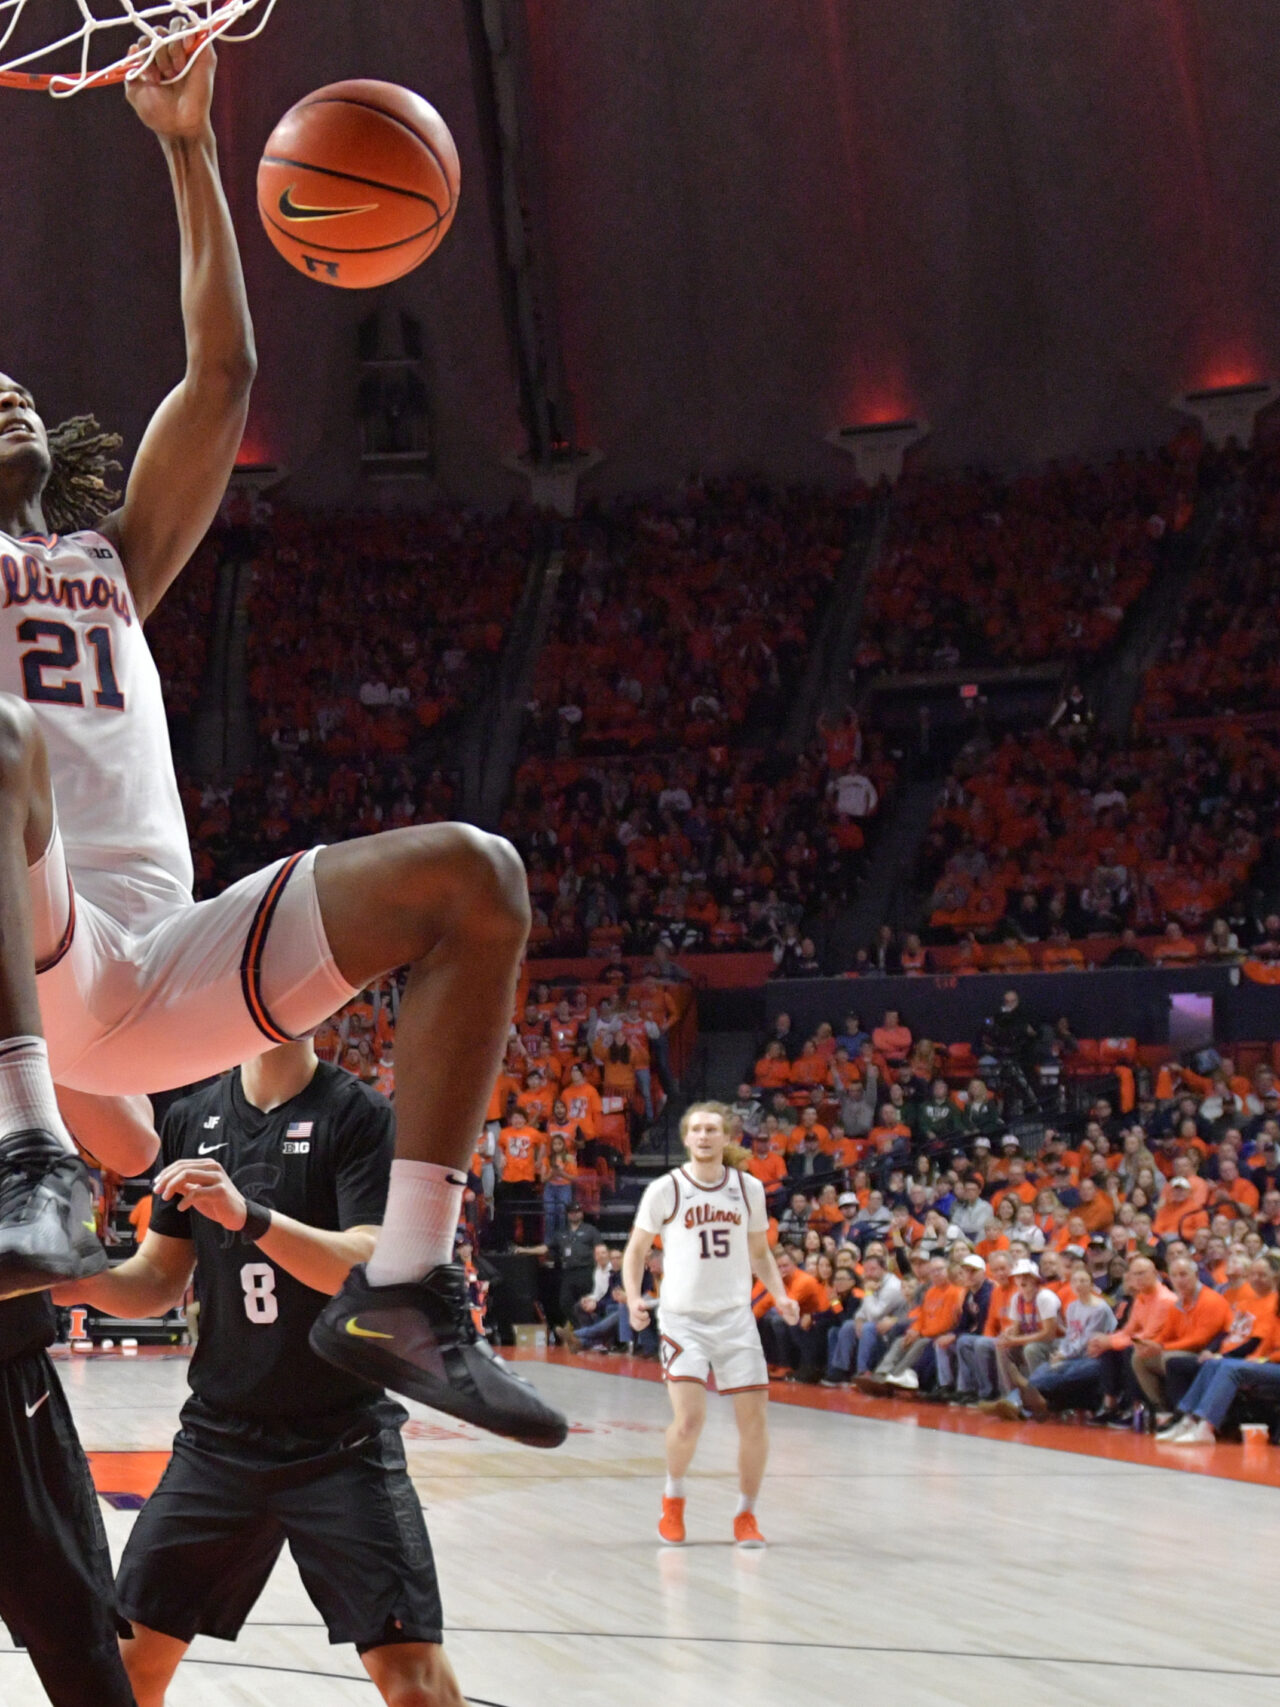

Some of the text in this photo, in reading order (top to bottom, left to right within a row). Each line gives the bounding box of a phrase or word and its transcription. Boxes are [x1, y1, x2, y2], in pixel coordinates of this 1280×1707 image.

[16, 617, 125, 711] 21
[203, 1115, 221, 1130] JF
[684, 1203, 742, 1230] Illinois
[699, 1229, 731, 1259] 15
[240, 1262, 279, 1324] 8
